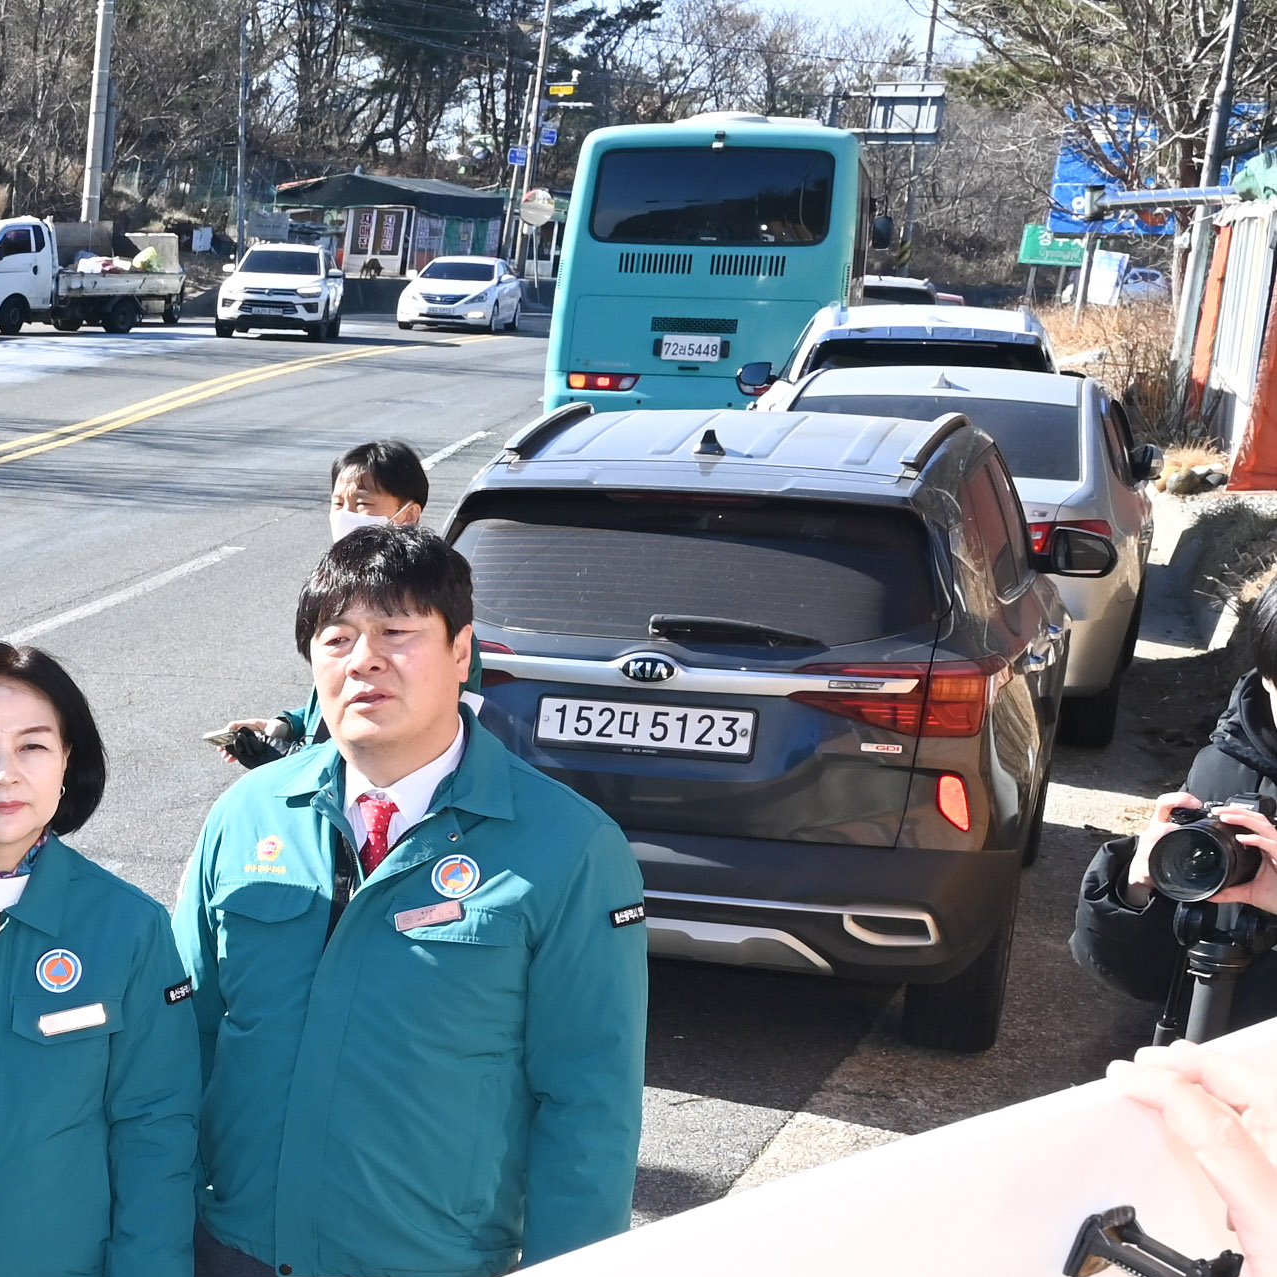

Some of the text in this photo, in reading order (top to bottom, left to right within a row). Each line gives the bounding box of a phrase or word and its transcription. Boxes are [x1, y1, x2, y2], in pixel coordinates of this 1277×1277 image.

[628, 660, 668, 679] KIA
[555, 704, 740, 747] 152다 5123
